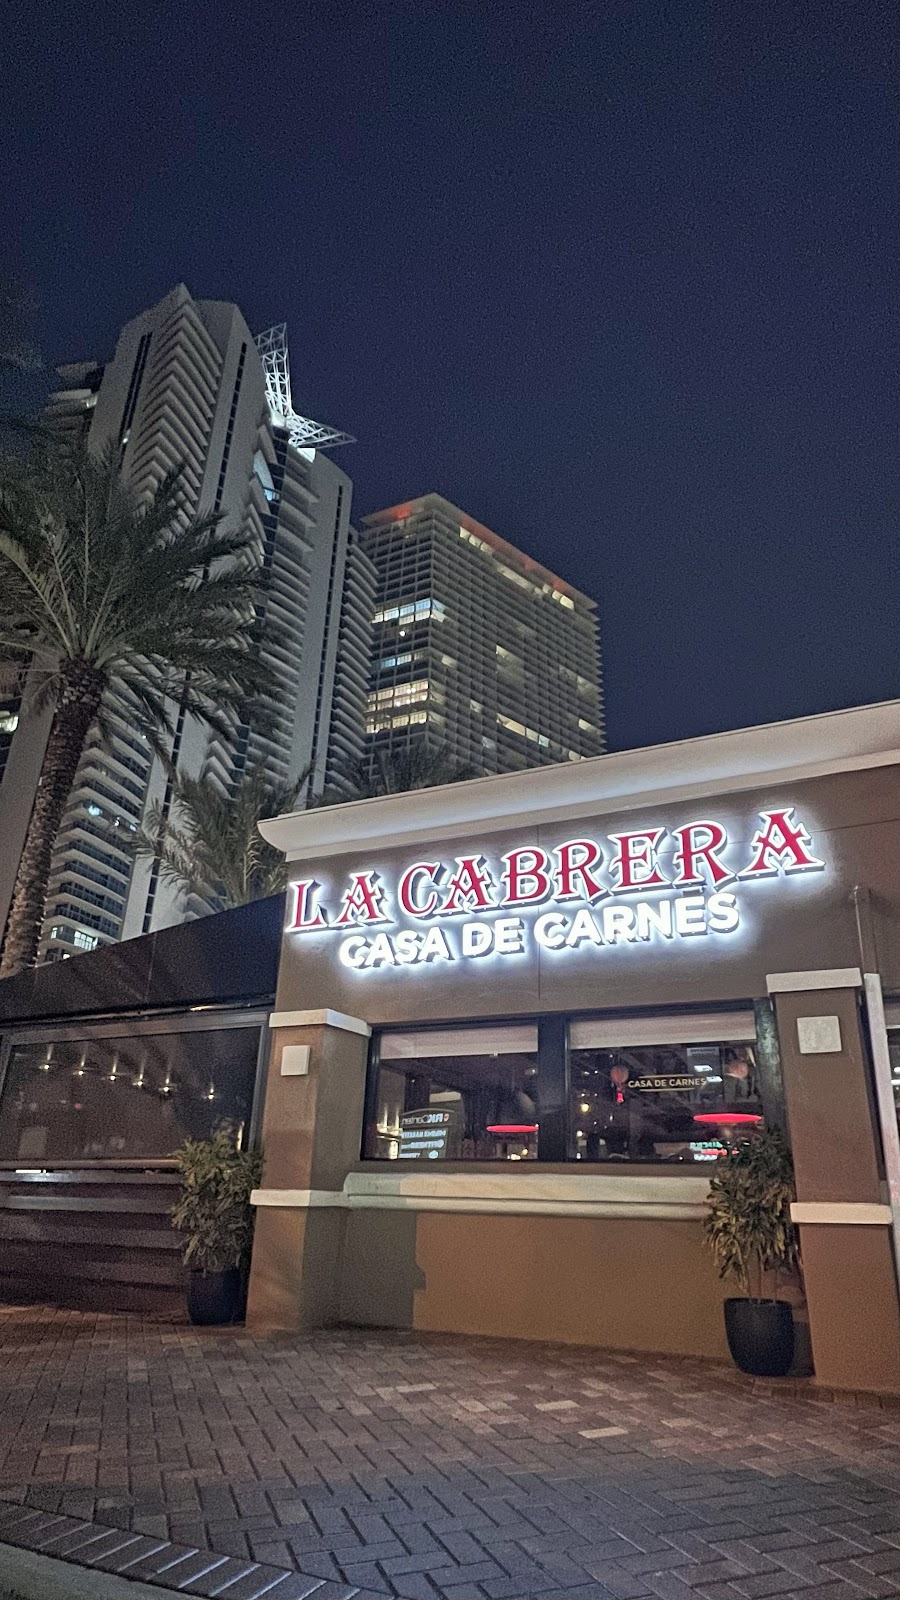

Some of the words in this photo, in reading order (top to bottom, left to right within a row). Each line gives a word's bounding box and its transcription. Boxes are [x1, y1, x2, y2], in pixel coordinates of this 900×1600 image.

[285, 870, 393, 934] LA
[399, 807, 825, 920] CABRERA
[340, 926, 454, 969] CASA
[462, 917, 525, 958] DE
[533, 892, 740, 950] CARNES
[628, 1080, 653, 1088] CASA
[654, 1079, 667, 1087] DE
[669, 1077, 707, 1086] CARNES
